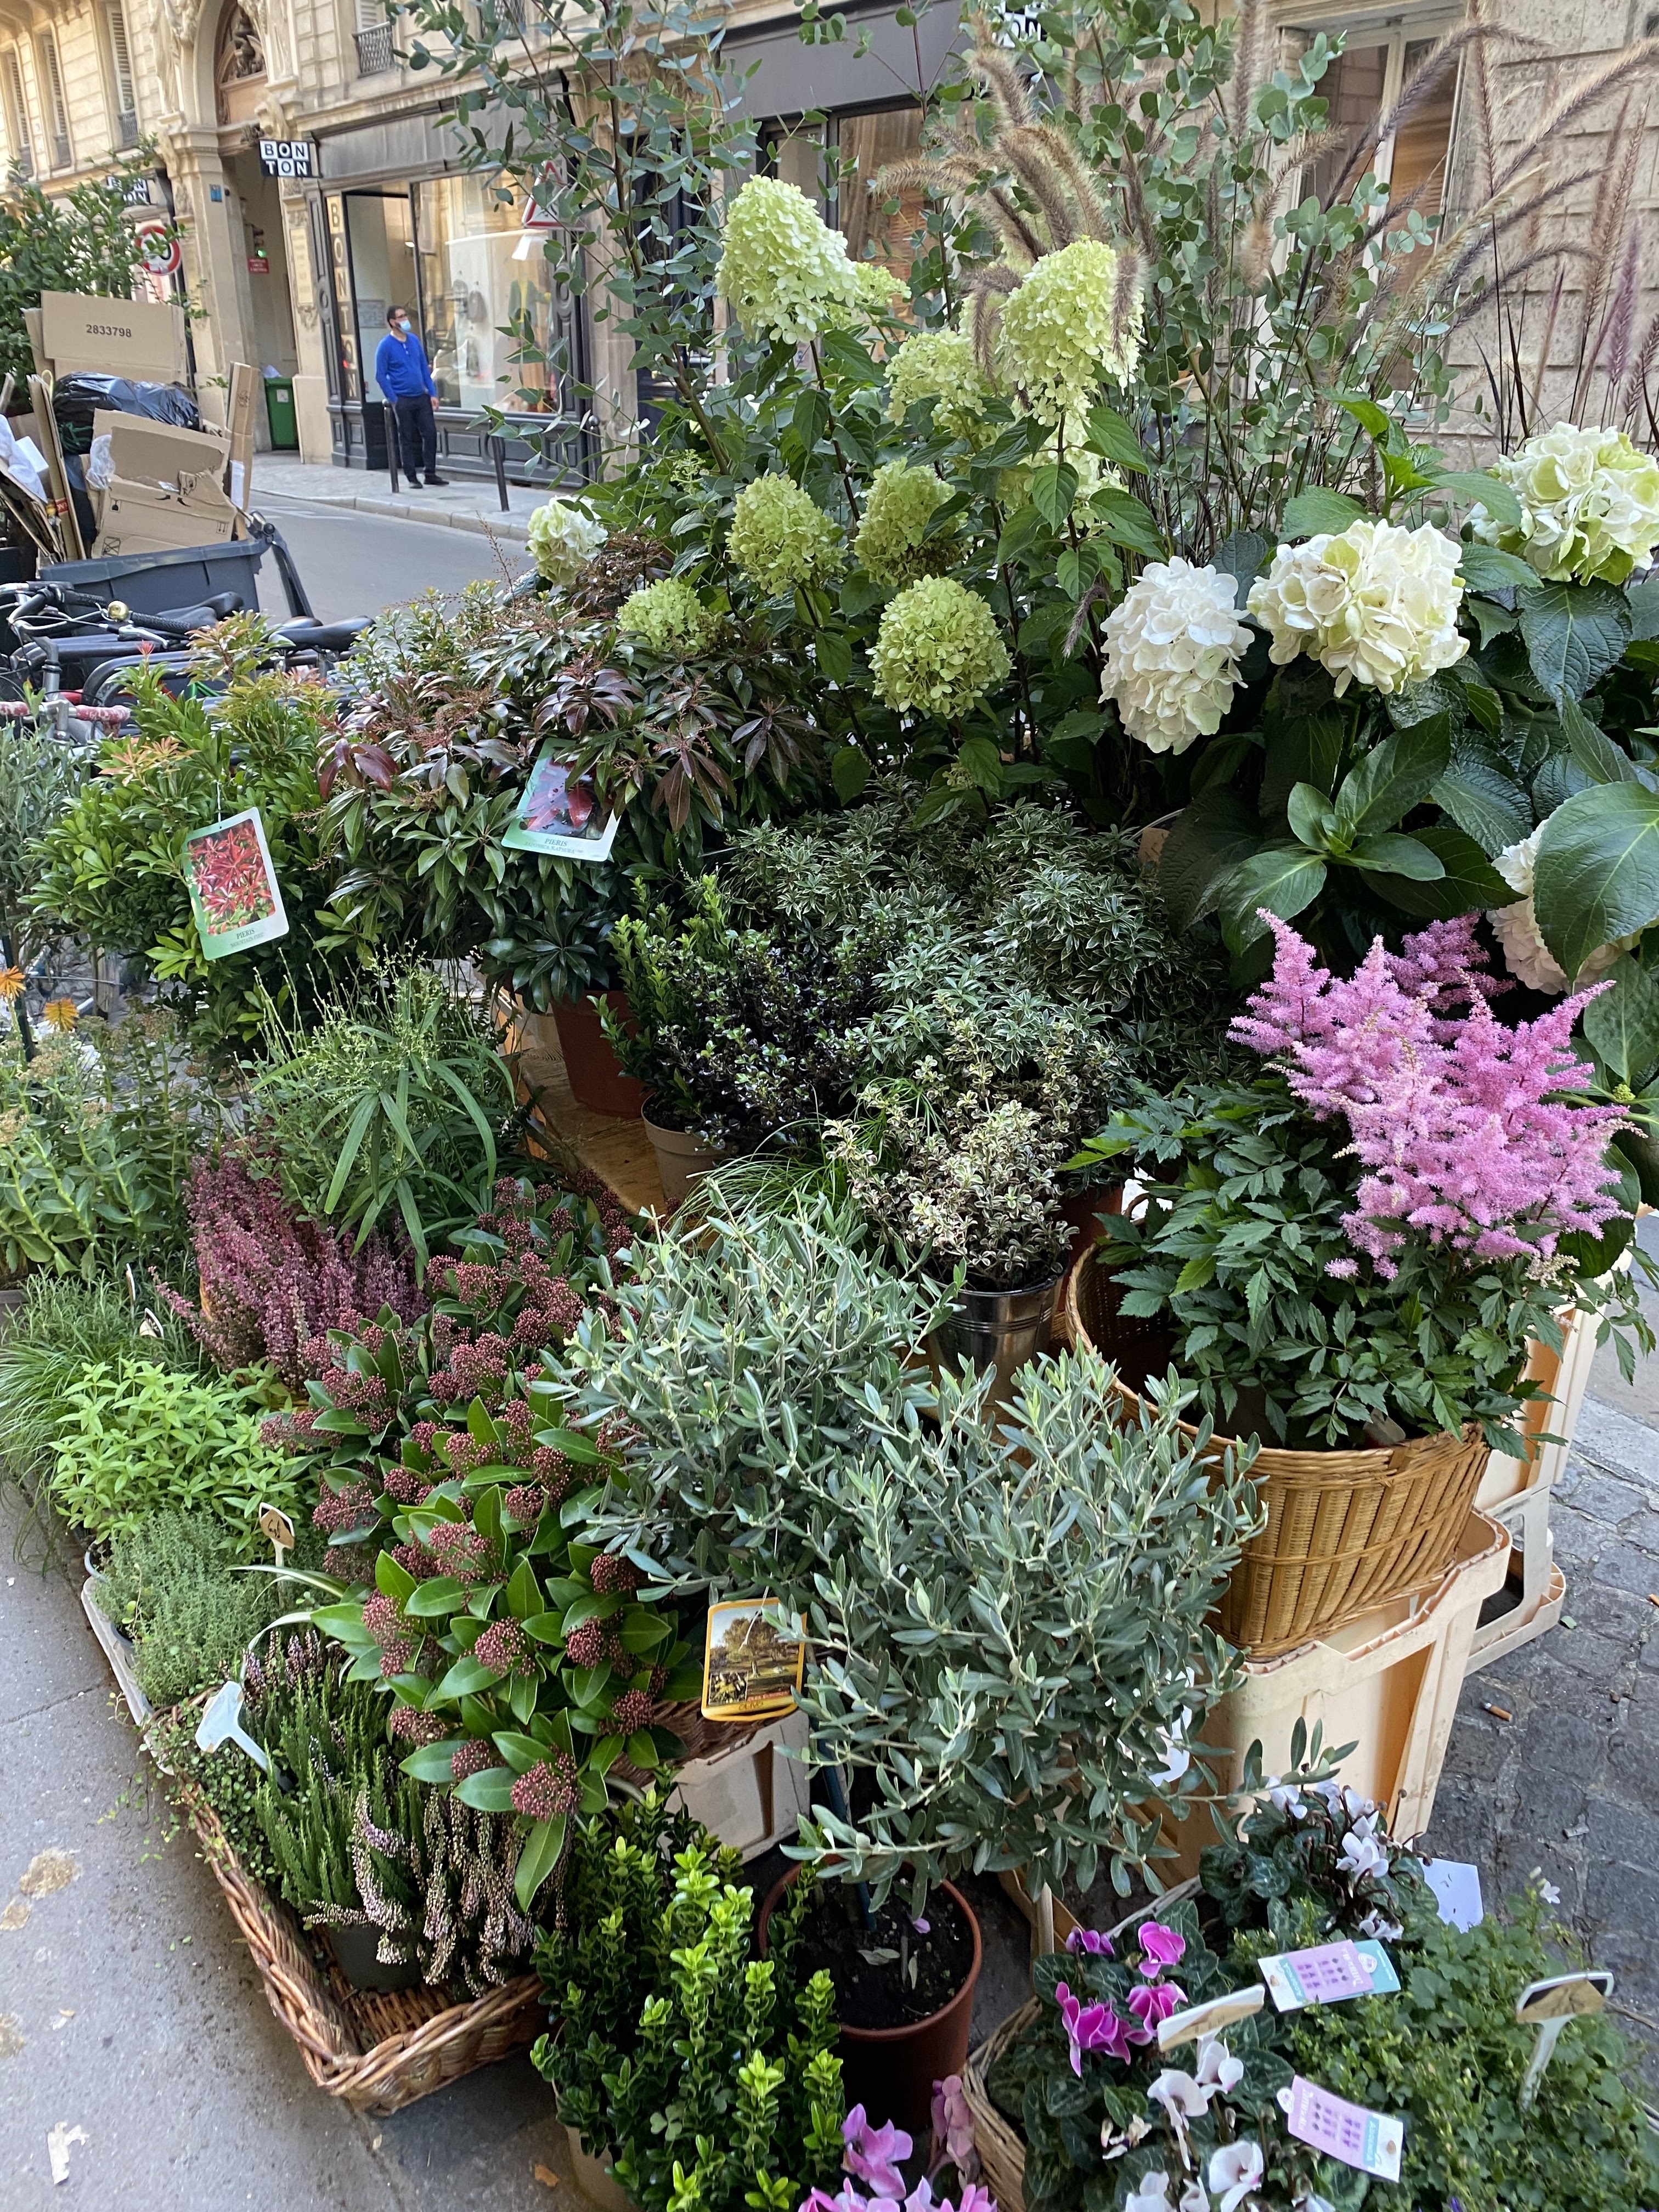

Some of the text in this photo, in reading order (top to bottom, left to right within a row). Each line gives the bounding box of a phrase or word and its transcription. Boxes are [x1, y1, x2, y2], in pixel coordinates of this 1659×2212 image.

[264, 144, 305, 157] BON
[266, 160, 307, 176] TON
[86, 324, 132, 337] 2833798
[544, 838, 568, 847] PIERIS
[236, 928, 255, 939] PIERIS
